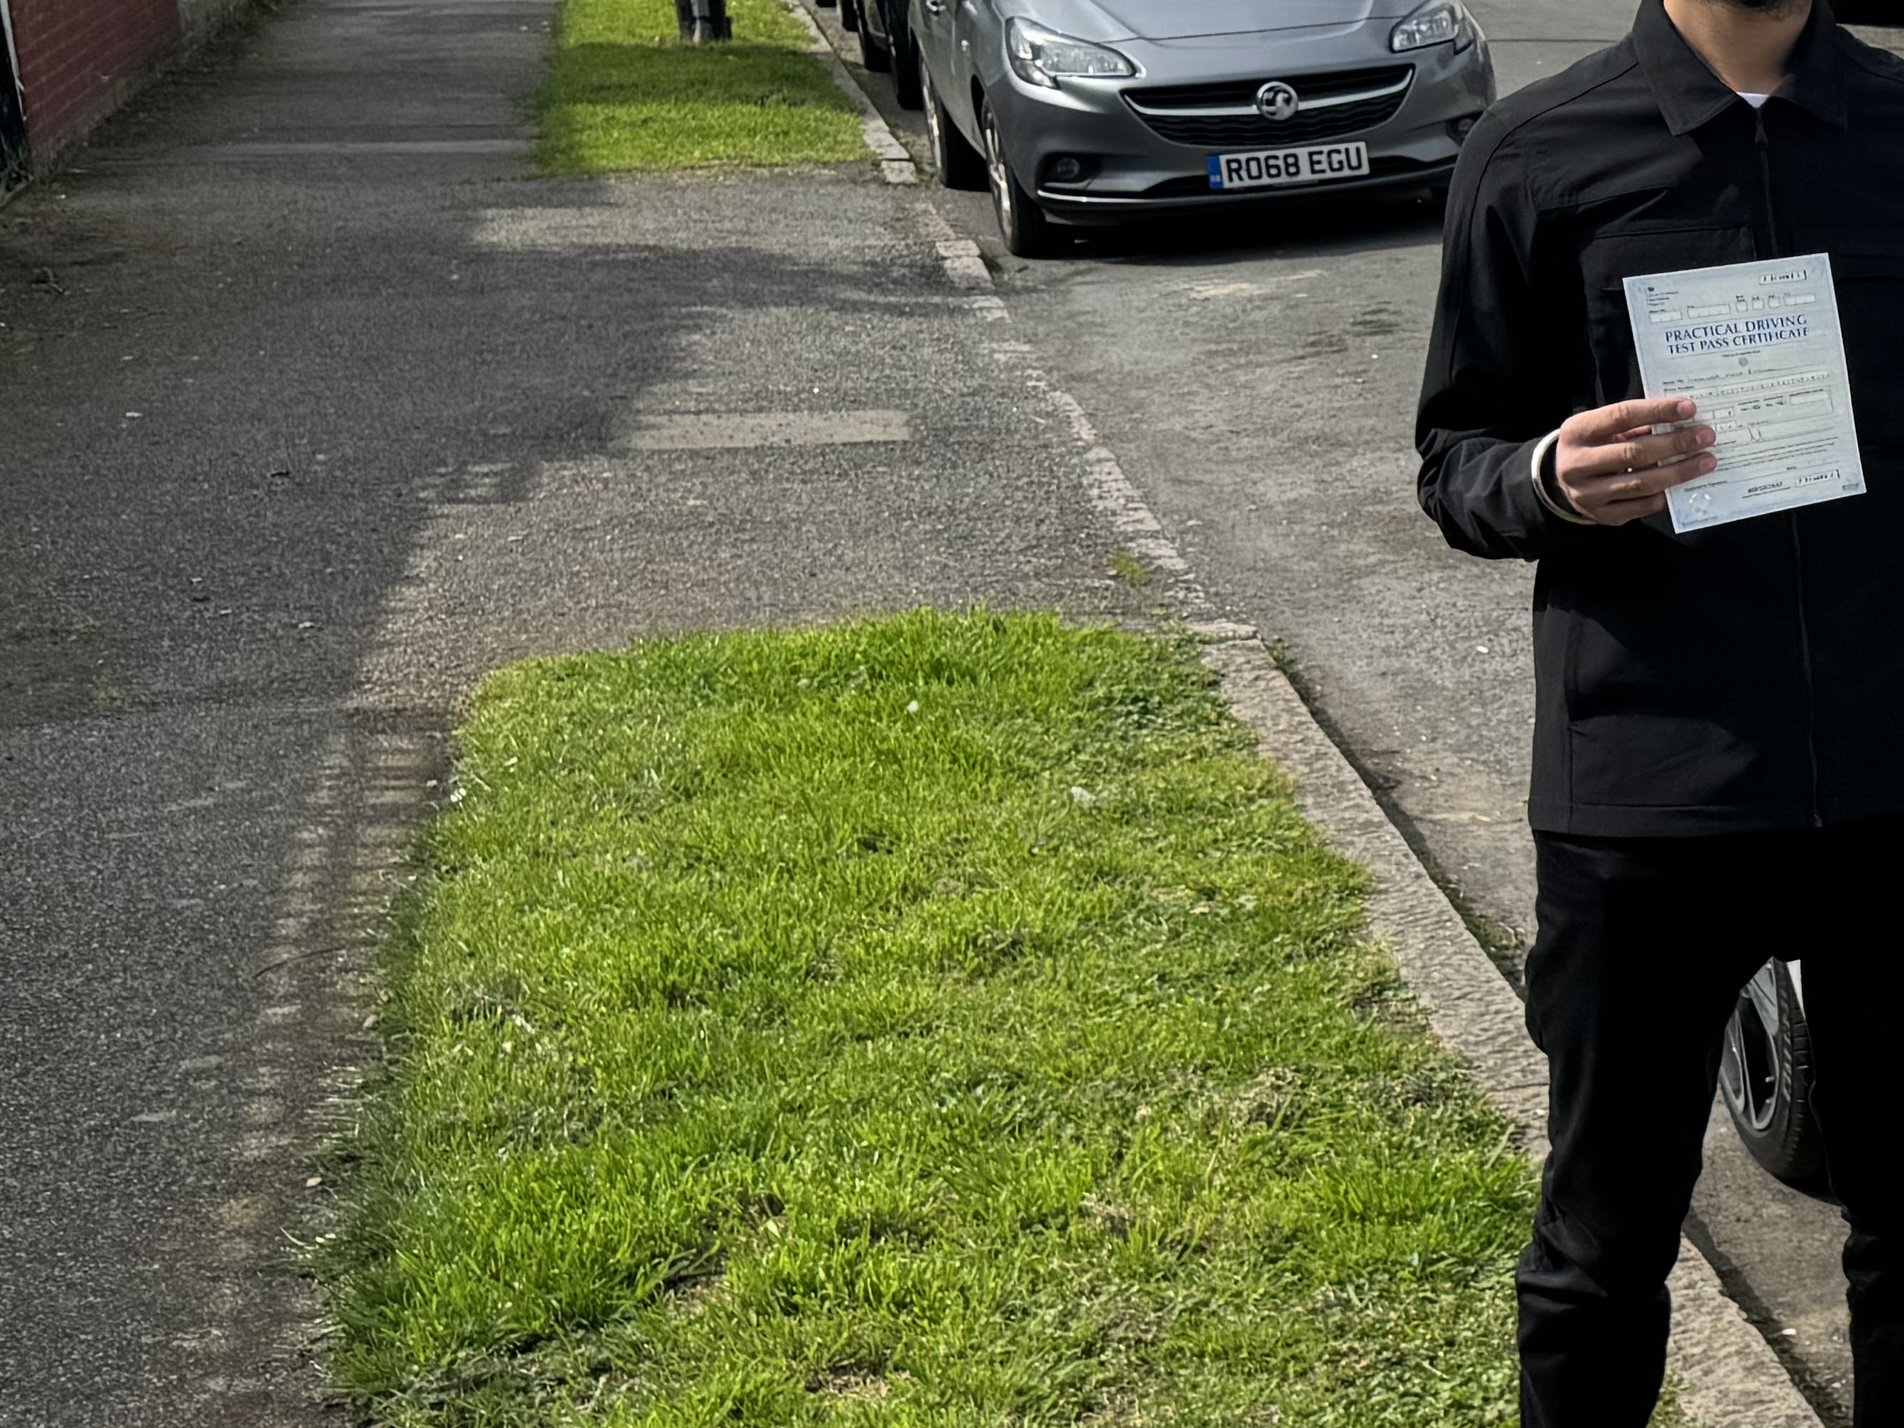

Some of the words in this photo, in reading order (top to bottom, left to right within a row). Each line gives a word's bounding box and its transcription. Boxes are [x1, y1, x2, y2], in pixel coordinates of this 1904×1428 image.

[1226, 153, 1300, 183] RO68
[1308, 146, 1362, 174] EGU
[1665, 323, 1741, 342] PRACTICAL
[1745, 314, 1808, 332] DRIVING
[1668, 341, 1697, 354] TEST
[1700, 337, 1729, 350] PASS
[1732, 327, 1809, 346] CERTIFICATE
